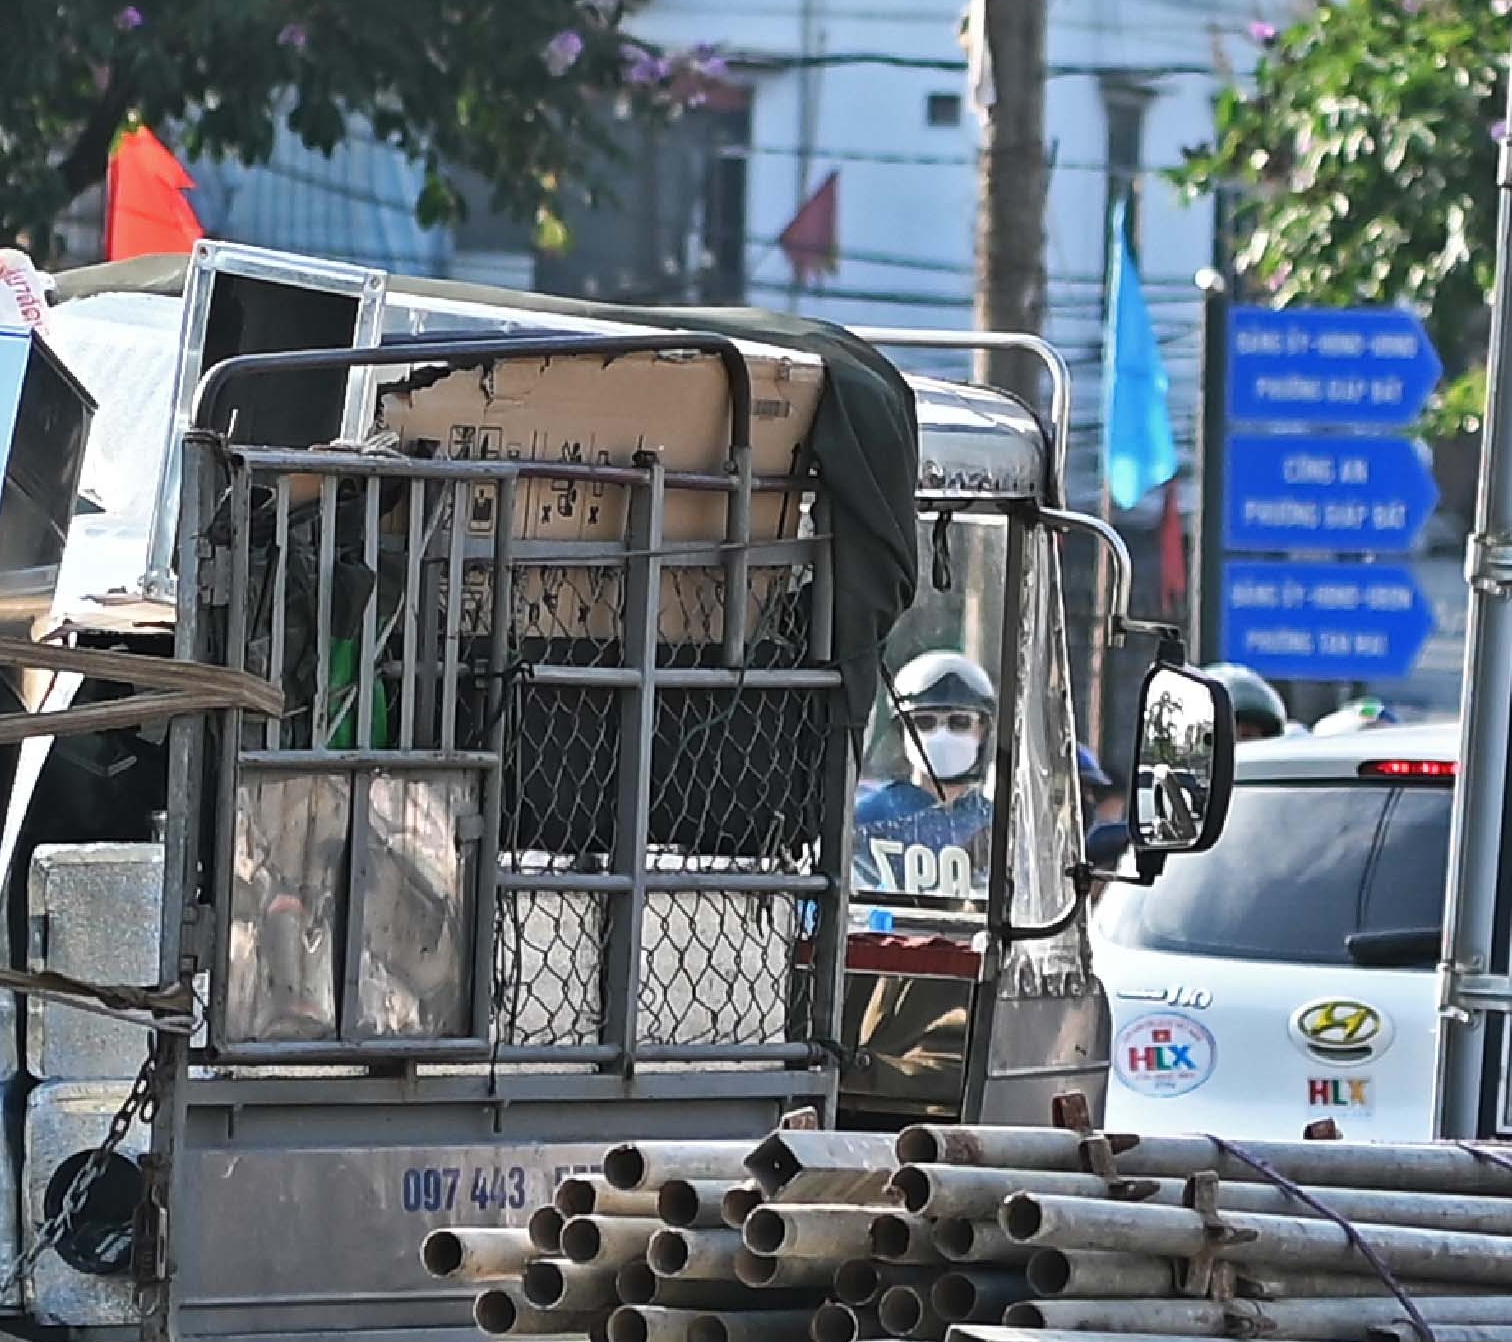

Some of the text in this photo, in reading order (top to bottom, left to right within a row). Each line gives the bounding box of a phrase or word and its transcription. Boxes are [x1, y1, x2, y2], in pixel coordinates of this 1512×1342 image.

[1128, 1044, 1197, 1072] HLX
[1308, 1078, 1372, 1105] HLX
[403, 1167, 461, 1212] 097
[470, 1166, 525, 1211] 443
